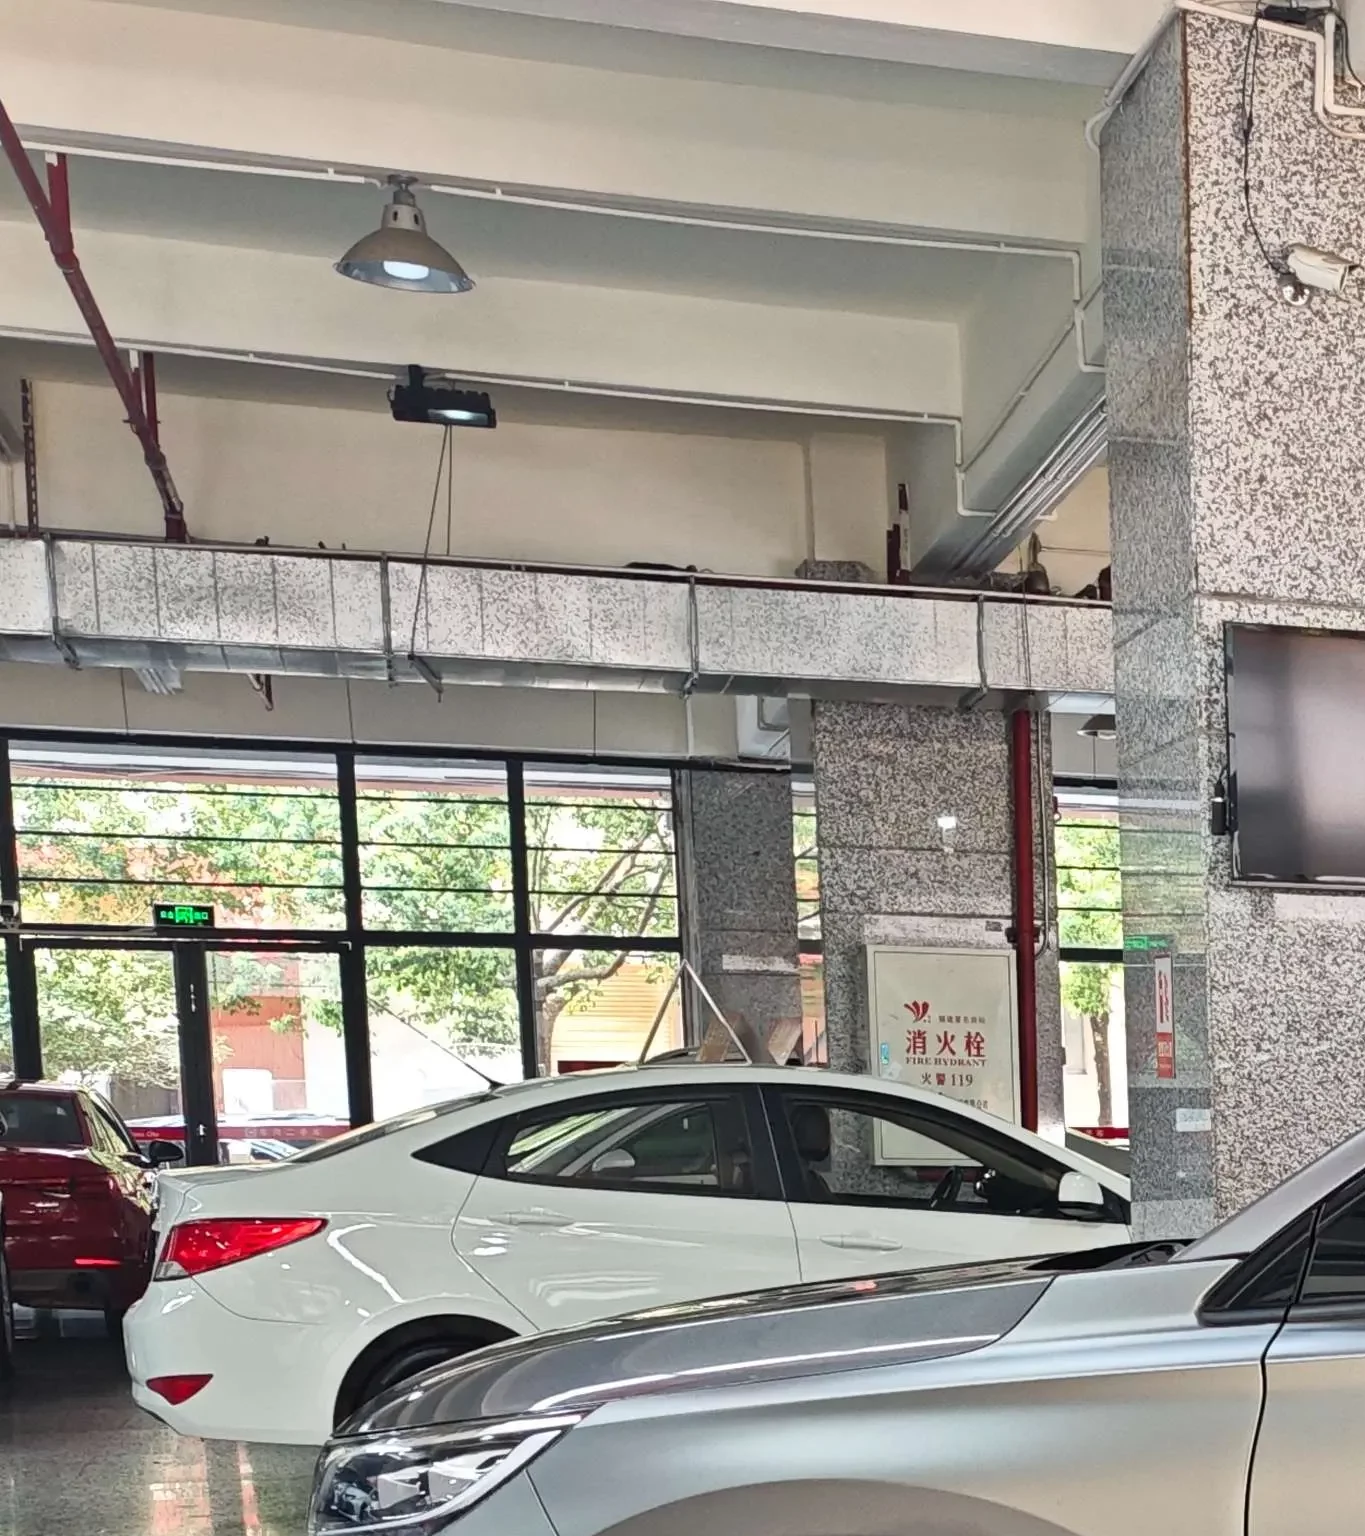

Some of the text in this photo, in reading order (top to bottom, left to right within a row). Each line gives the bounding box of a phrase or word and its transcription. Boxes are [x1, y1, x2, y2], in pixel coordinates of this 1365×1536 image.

[905, 1029, 986, 1057] 消火栓
[906, 1057, 987, 1067] FIRE HYDRANT
